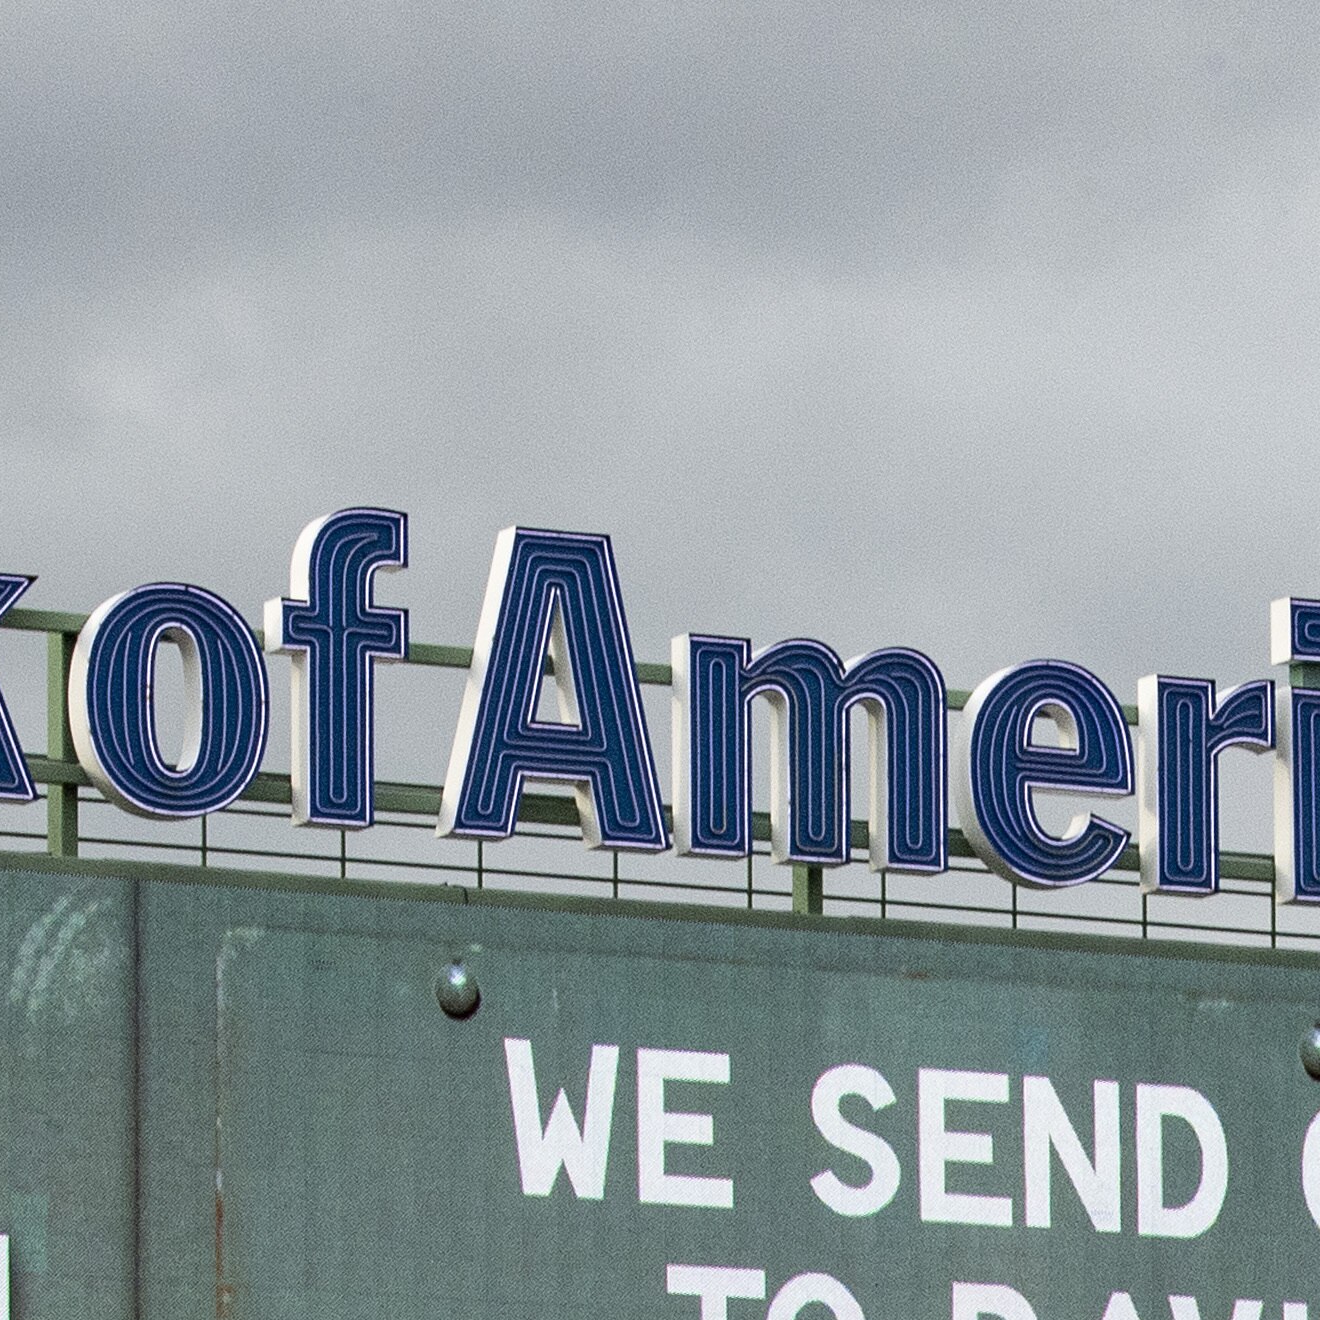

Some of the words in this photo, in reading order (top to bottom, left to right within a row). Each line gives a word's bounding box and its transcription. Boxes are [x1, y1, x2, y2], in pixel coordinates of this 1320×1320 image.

[68, 506, 409, 831] of
[503, 1037, 735, 1210] WE
[810, 1062, 1230, 1240] SEND
